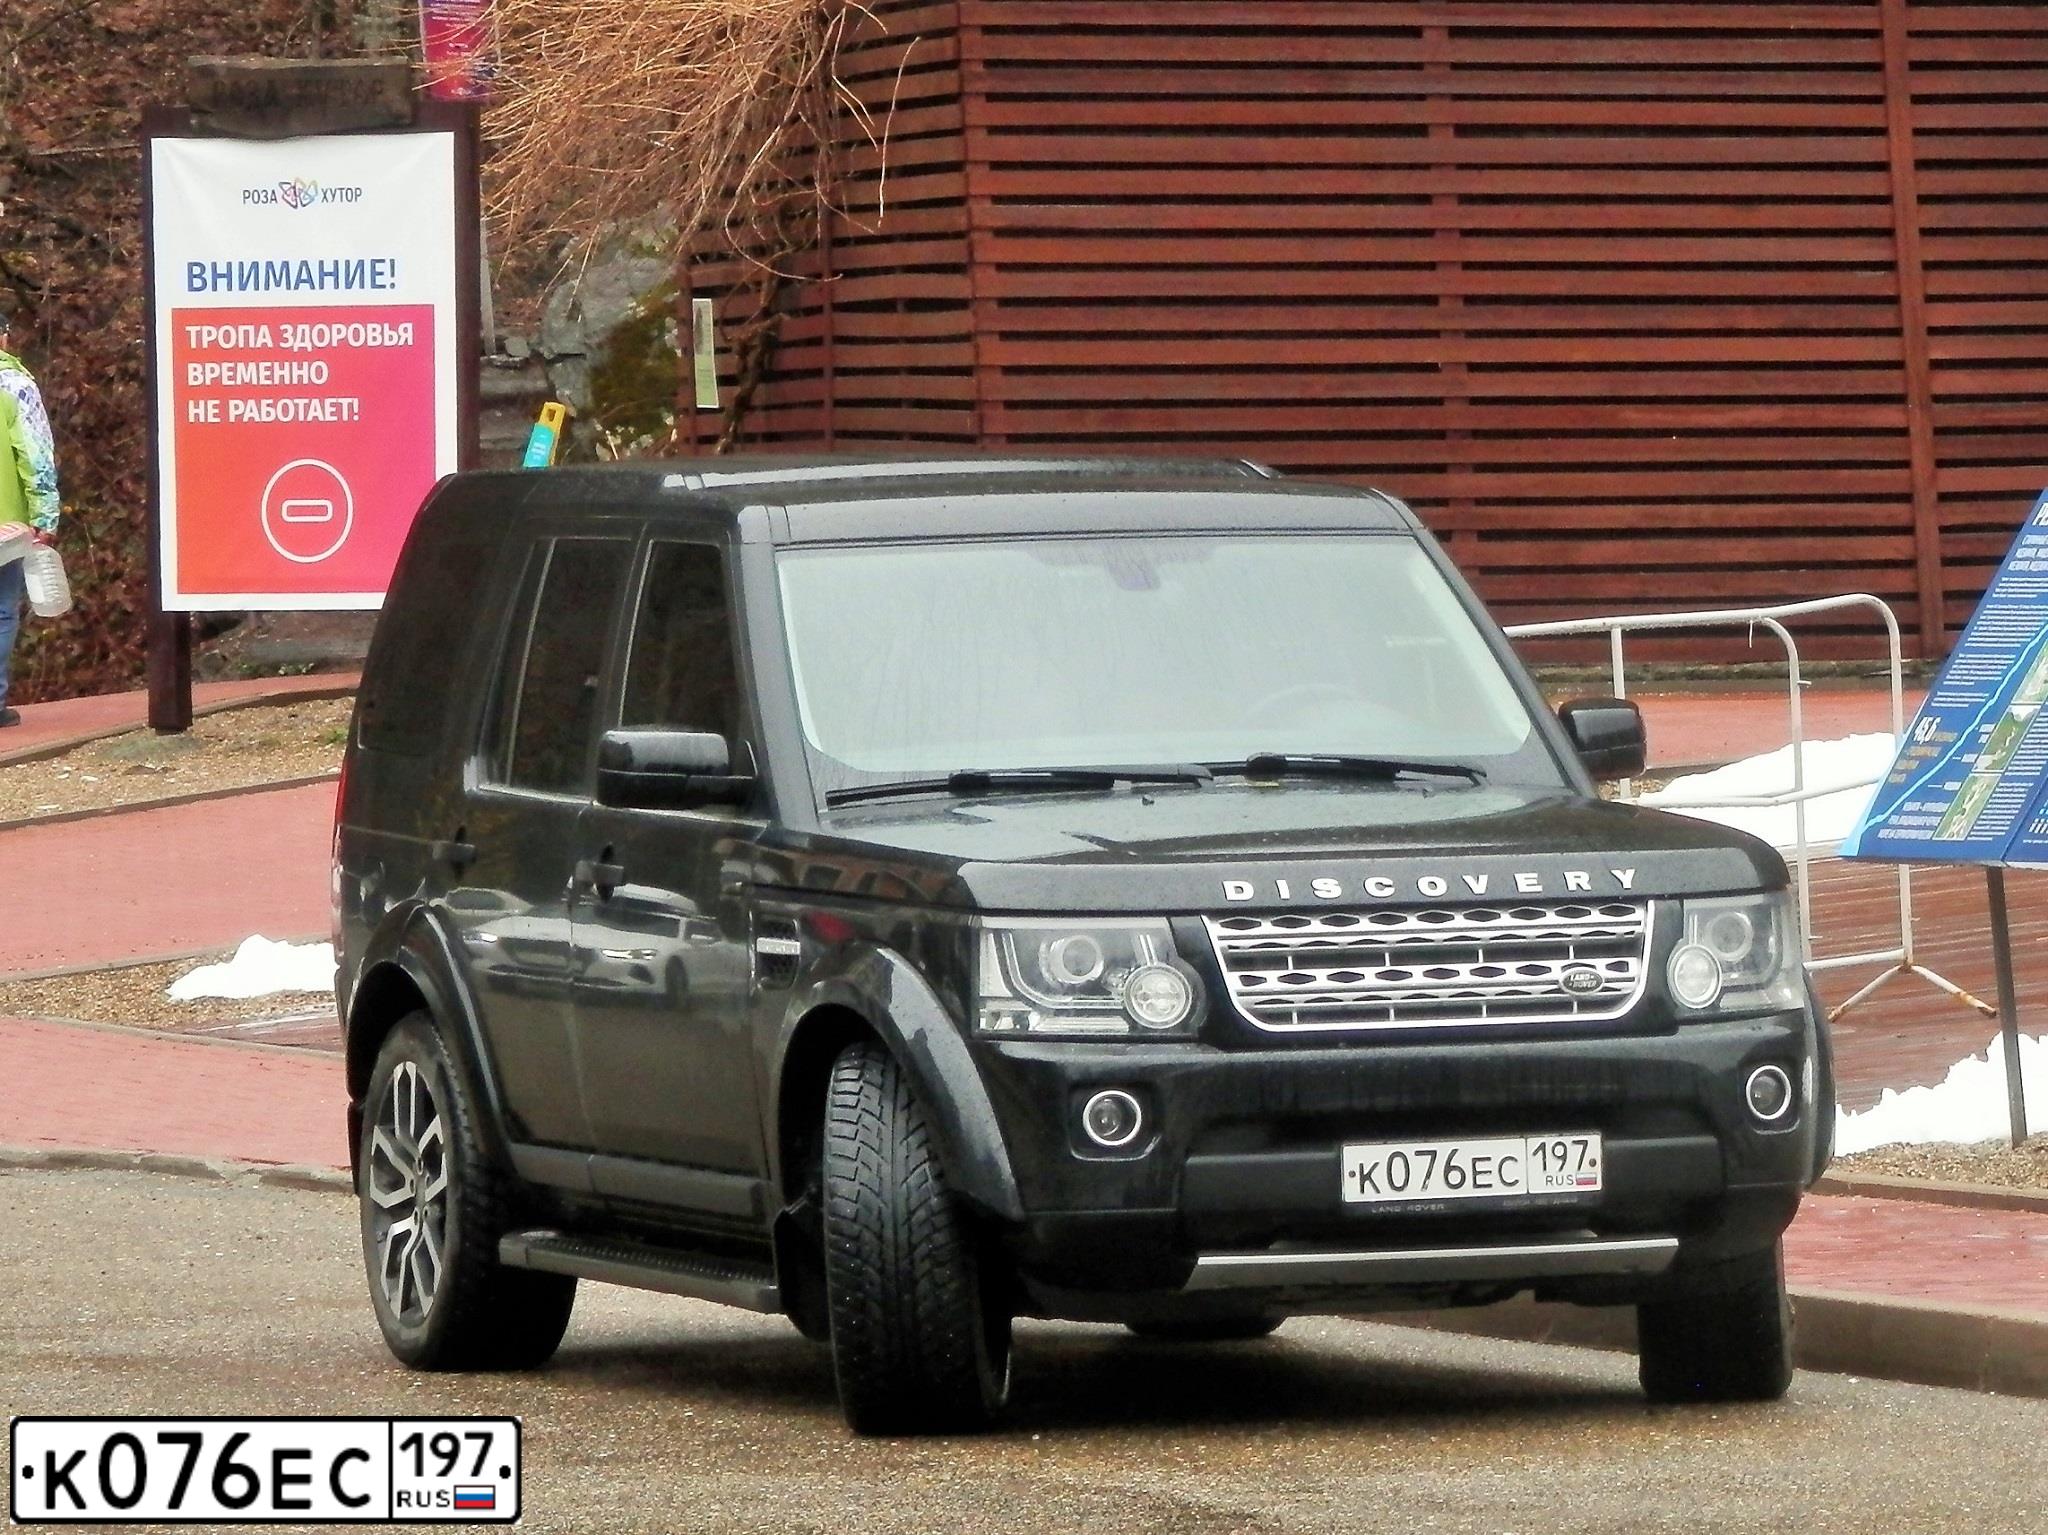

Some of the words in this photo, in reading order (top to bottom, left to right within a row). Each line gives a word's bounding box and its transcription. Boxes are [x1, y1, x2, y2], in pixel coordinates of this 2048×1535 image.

[242, 189, 278, 205] РОЗА
[320, 187, 362, 203] ХУТОР
[186, 258, 397, 293] ВНИМАНИЕ!
[185, 324, 273, 350] ТРОПА
[279, 322, 414, 352] ЗДОРОВЬЯ
[186, 360, 329, 387] ВРЕМЕННО
[187, 400, 221, 423] НЕ
[228, 397, 360, 423] РАБОТАЕТ!
[1222, 868, 1637, 902] DISCOVERY
[1531, 1139, 1589, 1173] 197
[1545, 1174, 1574, 1187] RUS
